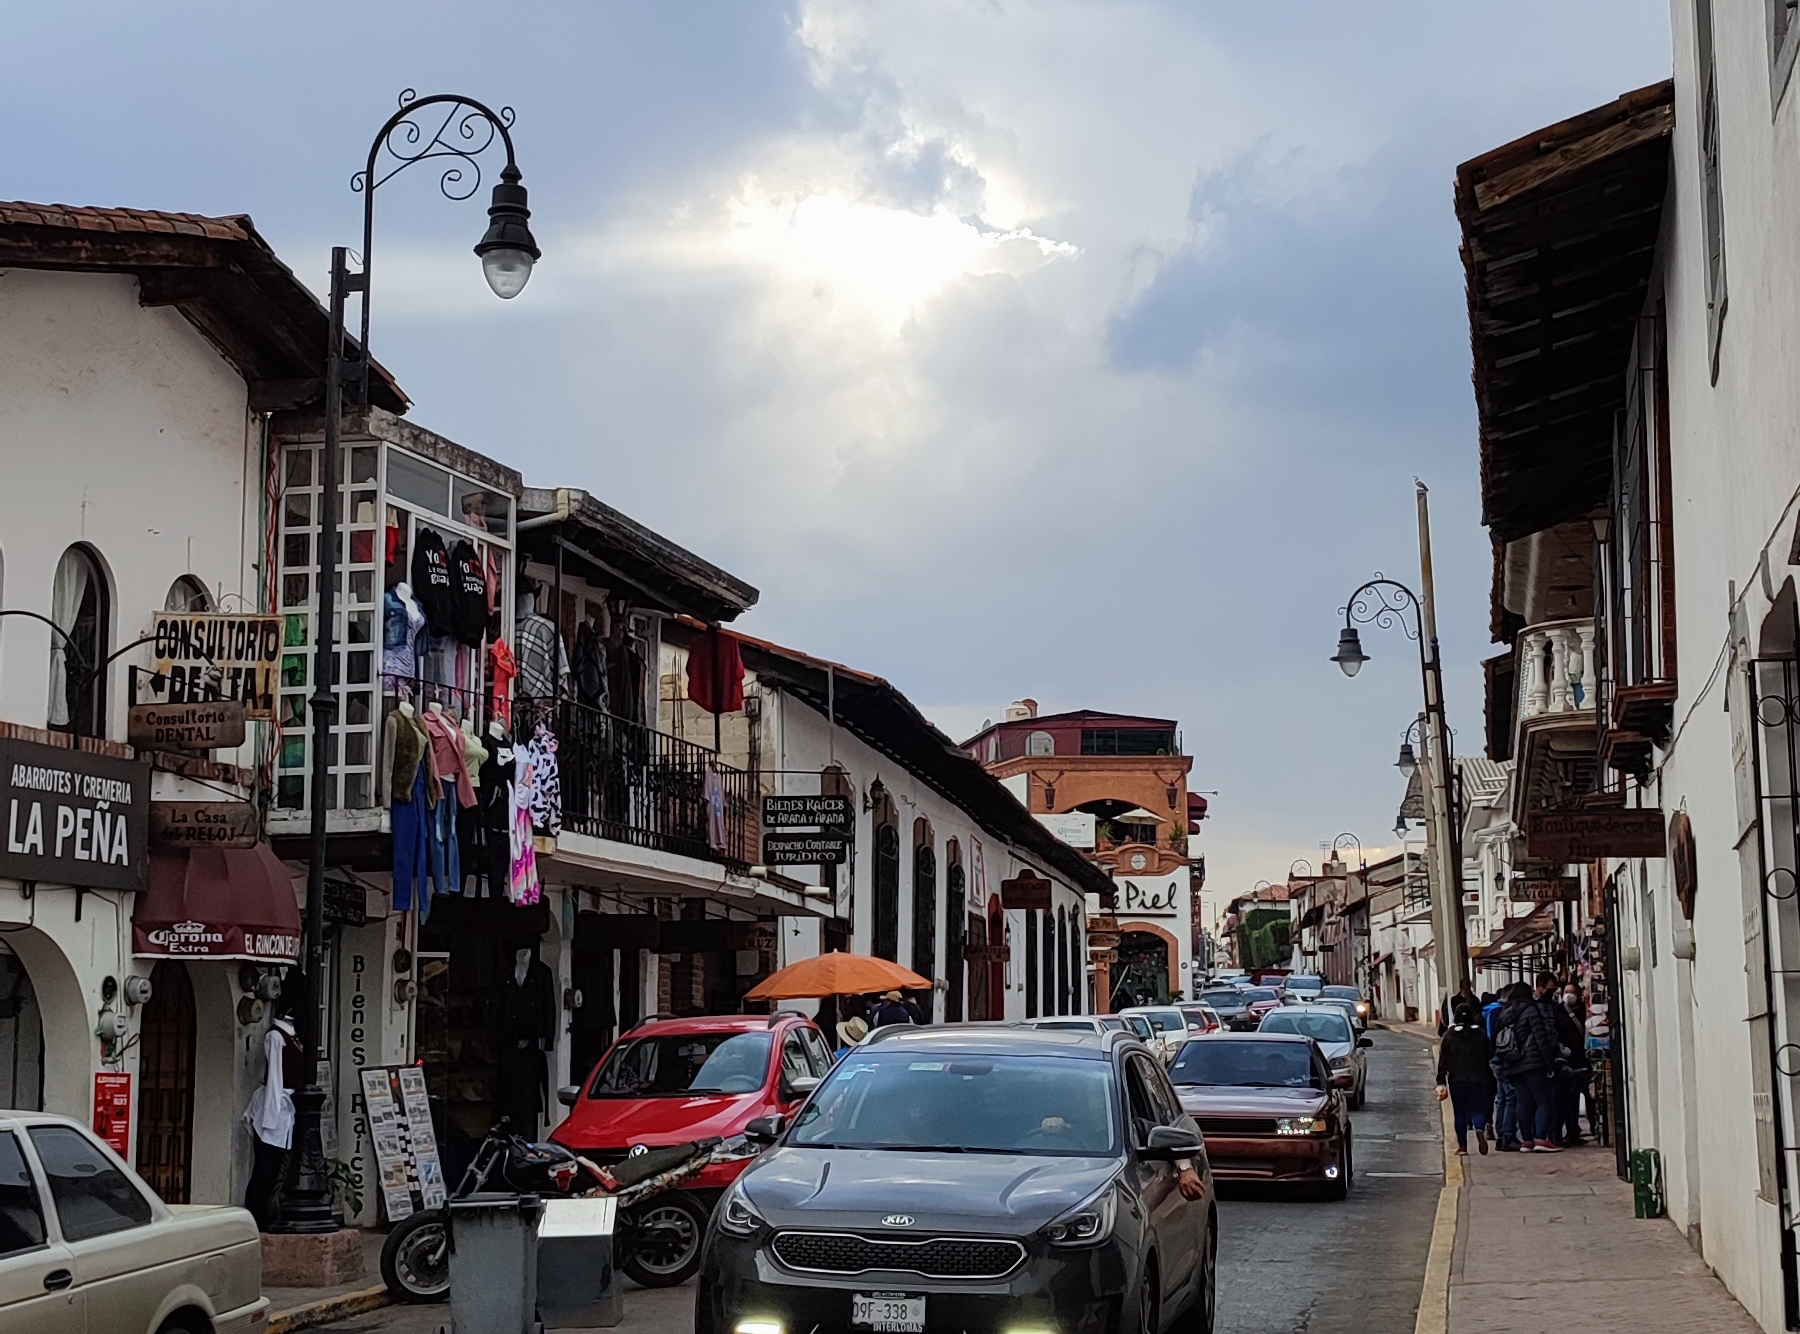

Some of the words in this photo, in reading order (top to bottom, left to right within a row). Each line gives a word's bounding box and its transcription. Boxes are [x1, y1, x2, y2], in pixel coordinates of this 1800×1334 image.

[154, 619, 280, 663] CONSULTORIO
[168, 665, 274, 710] DENTAL
[146, 709, 227, 727] Consultorio
[154, 725, 216, 745] DENTAL
[11, 763, 72, 795] ABARROTES
[74, 772, 82, 796] Y
[83, 774, 132, 805] CREMERIA
[171, 809, 188, 824] La
[194, 809, 228, 824] Casa
[8, 798, 44, 856] LA
[55, 800, 129, 867] PEÑA
[186, 826, 238, 842] RELOJ
[1125, 880, 1177, 910] Piel
[148, 929, 223, 946] Corona
[169, 942, 209, 952] Extra
[245, 933, 254, 954] EL
[353, 956, 366, 1066] Bienes
[887, 1216, 910, 1225] KIA
